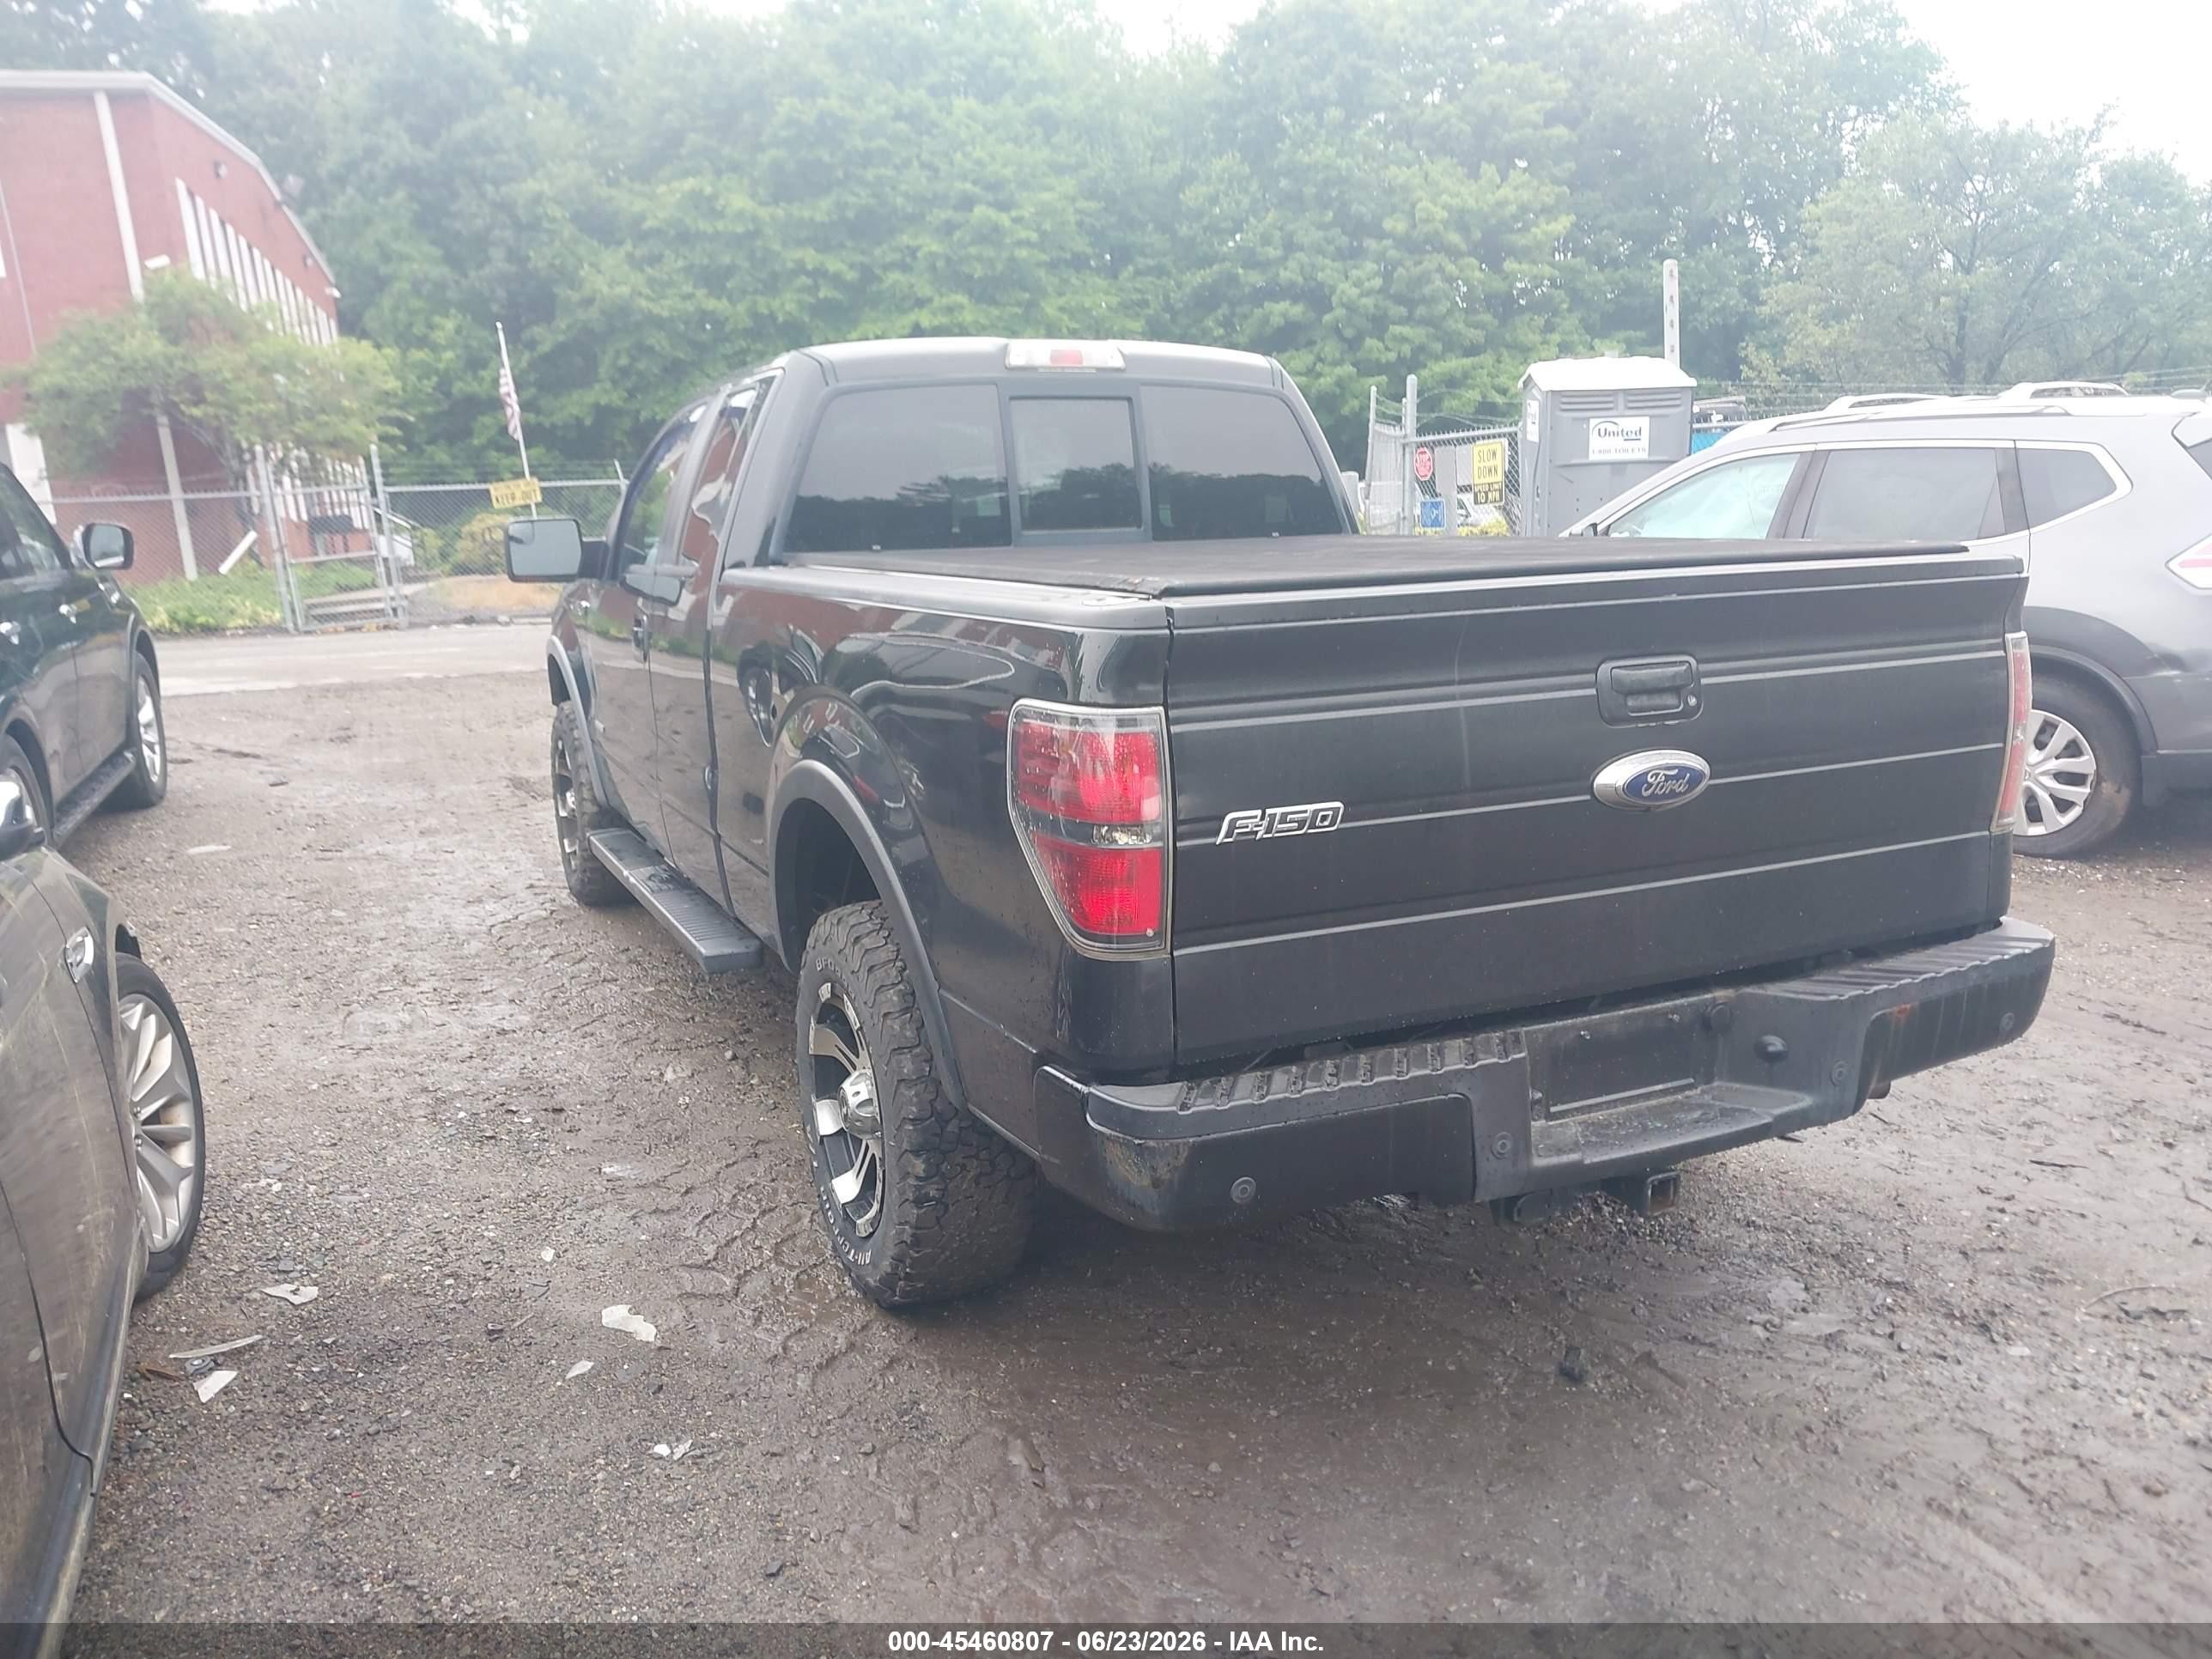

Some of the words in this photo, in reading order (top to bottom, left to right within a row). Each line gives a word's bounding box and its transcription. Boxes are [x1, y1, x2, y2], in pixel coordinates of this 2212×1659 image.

[1597, 426, 1642, 438] United
[1478, 448, 1498, 463] SLOW
[1478, 465, 1498, 479] DOWN
[1477, 491, 1486, 503] 10
[1487, 490, 1500, 502] MPH
[1641, 769, 1690, 797] Ford
[1216, 801, 1344, 845] F-150
